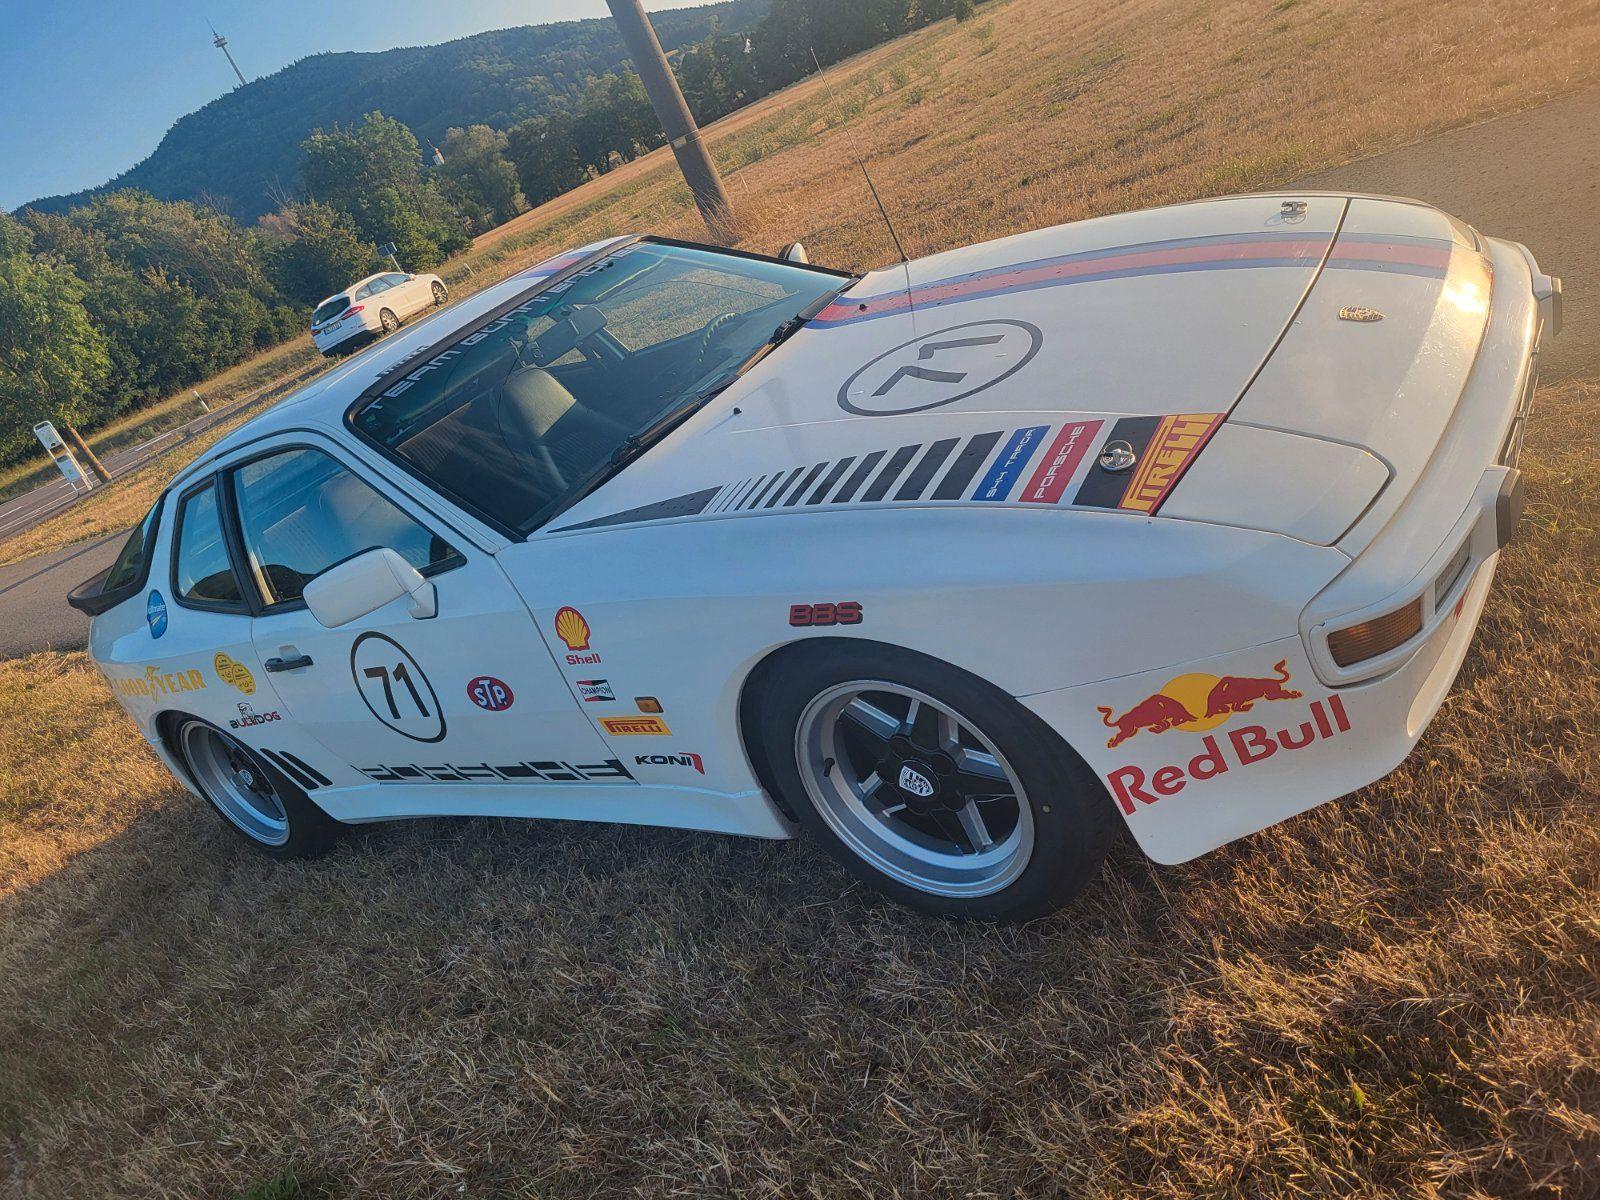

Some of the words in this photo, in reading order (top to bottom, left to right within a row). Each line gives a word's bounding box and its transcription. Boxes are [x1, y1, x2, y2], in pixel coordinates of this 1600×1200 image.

[360, 350, 461, 415] TEAM
[871, 335, 1005, 397] 71
[1004, 429, 1035, 467] TARGA
[1034, 426, 1085, 498] PORSCHE
[1121, 413, 1219, 511] PIRELLI
[789, 601, 863, 627] BBS
[566, 653, 601, 665] Shell
[364, 662, 430, 719] 71
[474, 680, 506, 708] STP
[604, 720, 663, 733] PIRELLI
[635, 755, 693, 766] KONI
[1107, 735, 1229, 816] Red
[1228, 694, 1352, 766] Bull
